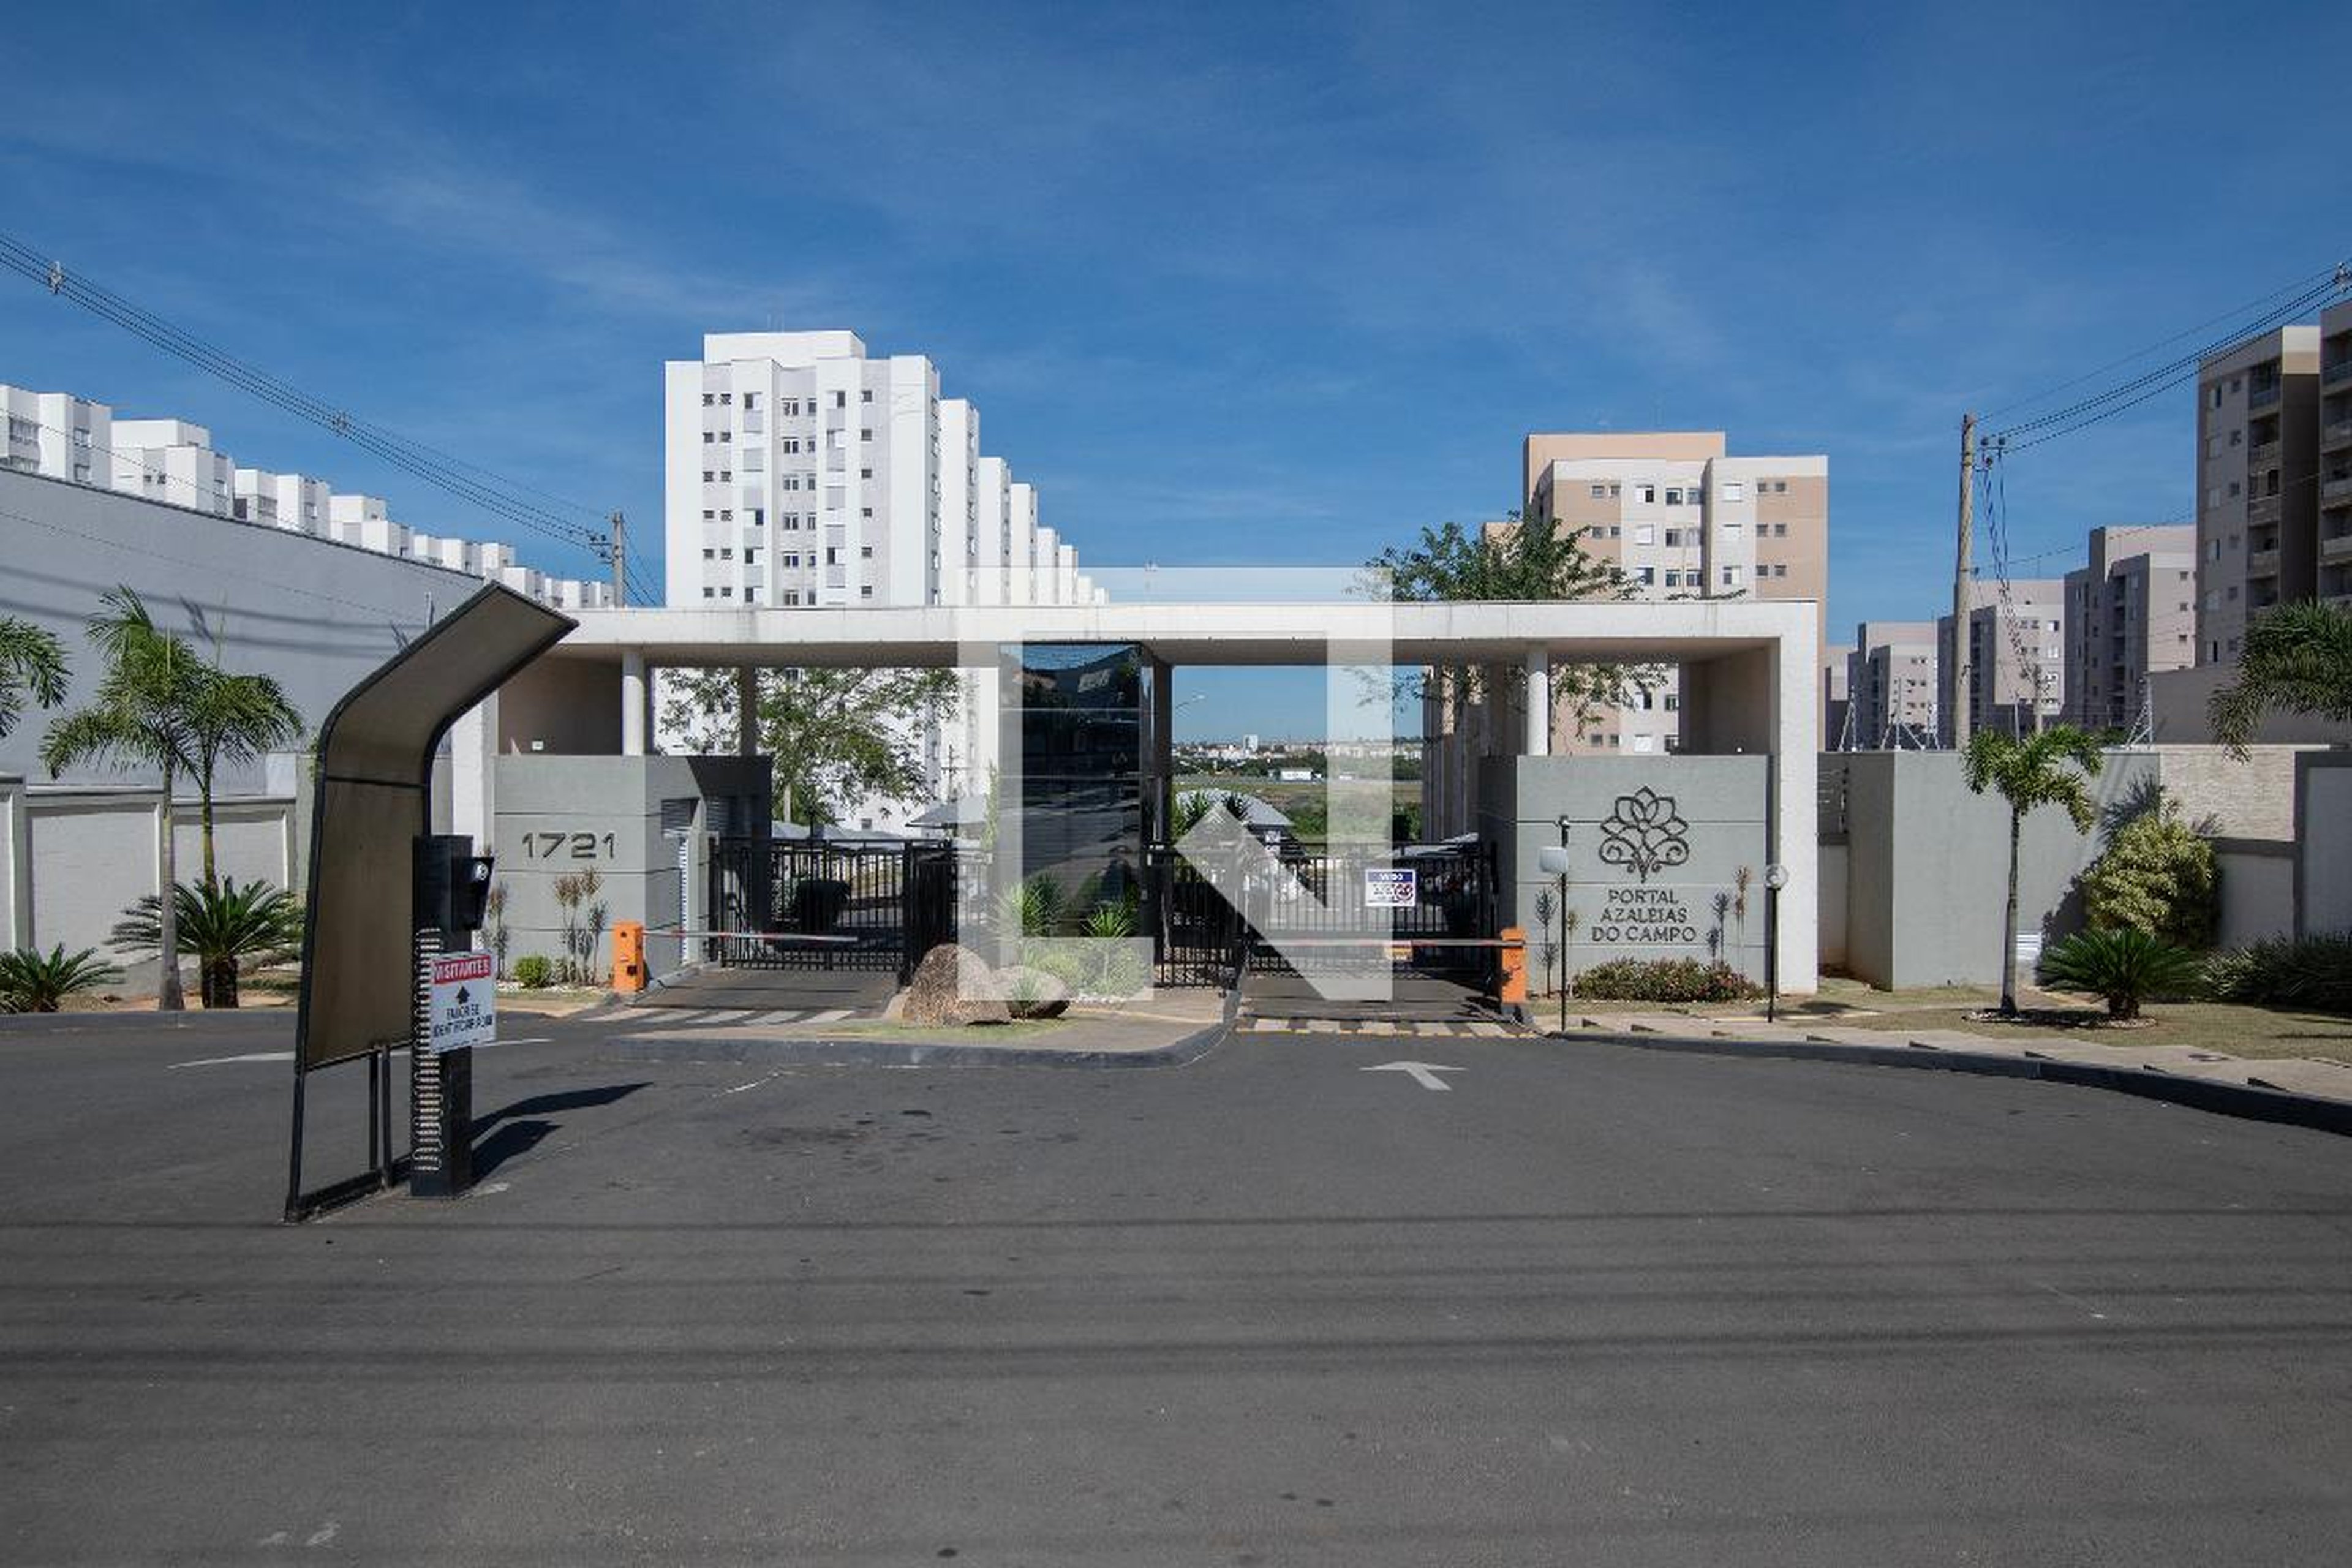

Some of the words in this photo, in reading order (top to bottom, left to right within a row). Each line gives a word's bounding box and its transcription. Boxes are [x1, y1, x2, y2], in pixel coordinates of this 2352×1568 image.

[522, 832, 616, 858] 1721
[1608, 889, 1679, 904] PORTAL
[1600, 908, 1688, 923] AZALEIAS
[1592, 926, 1620, 942] DO
[1626, 926, 1697, 942] CAMPO
[435, 959, 489, 979] VISITANTES
